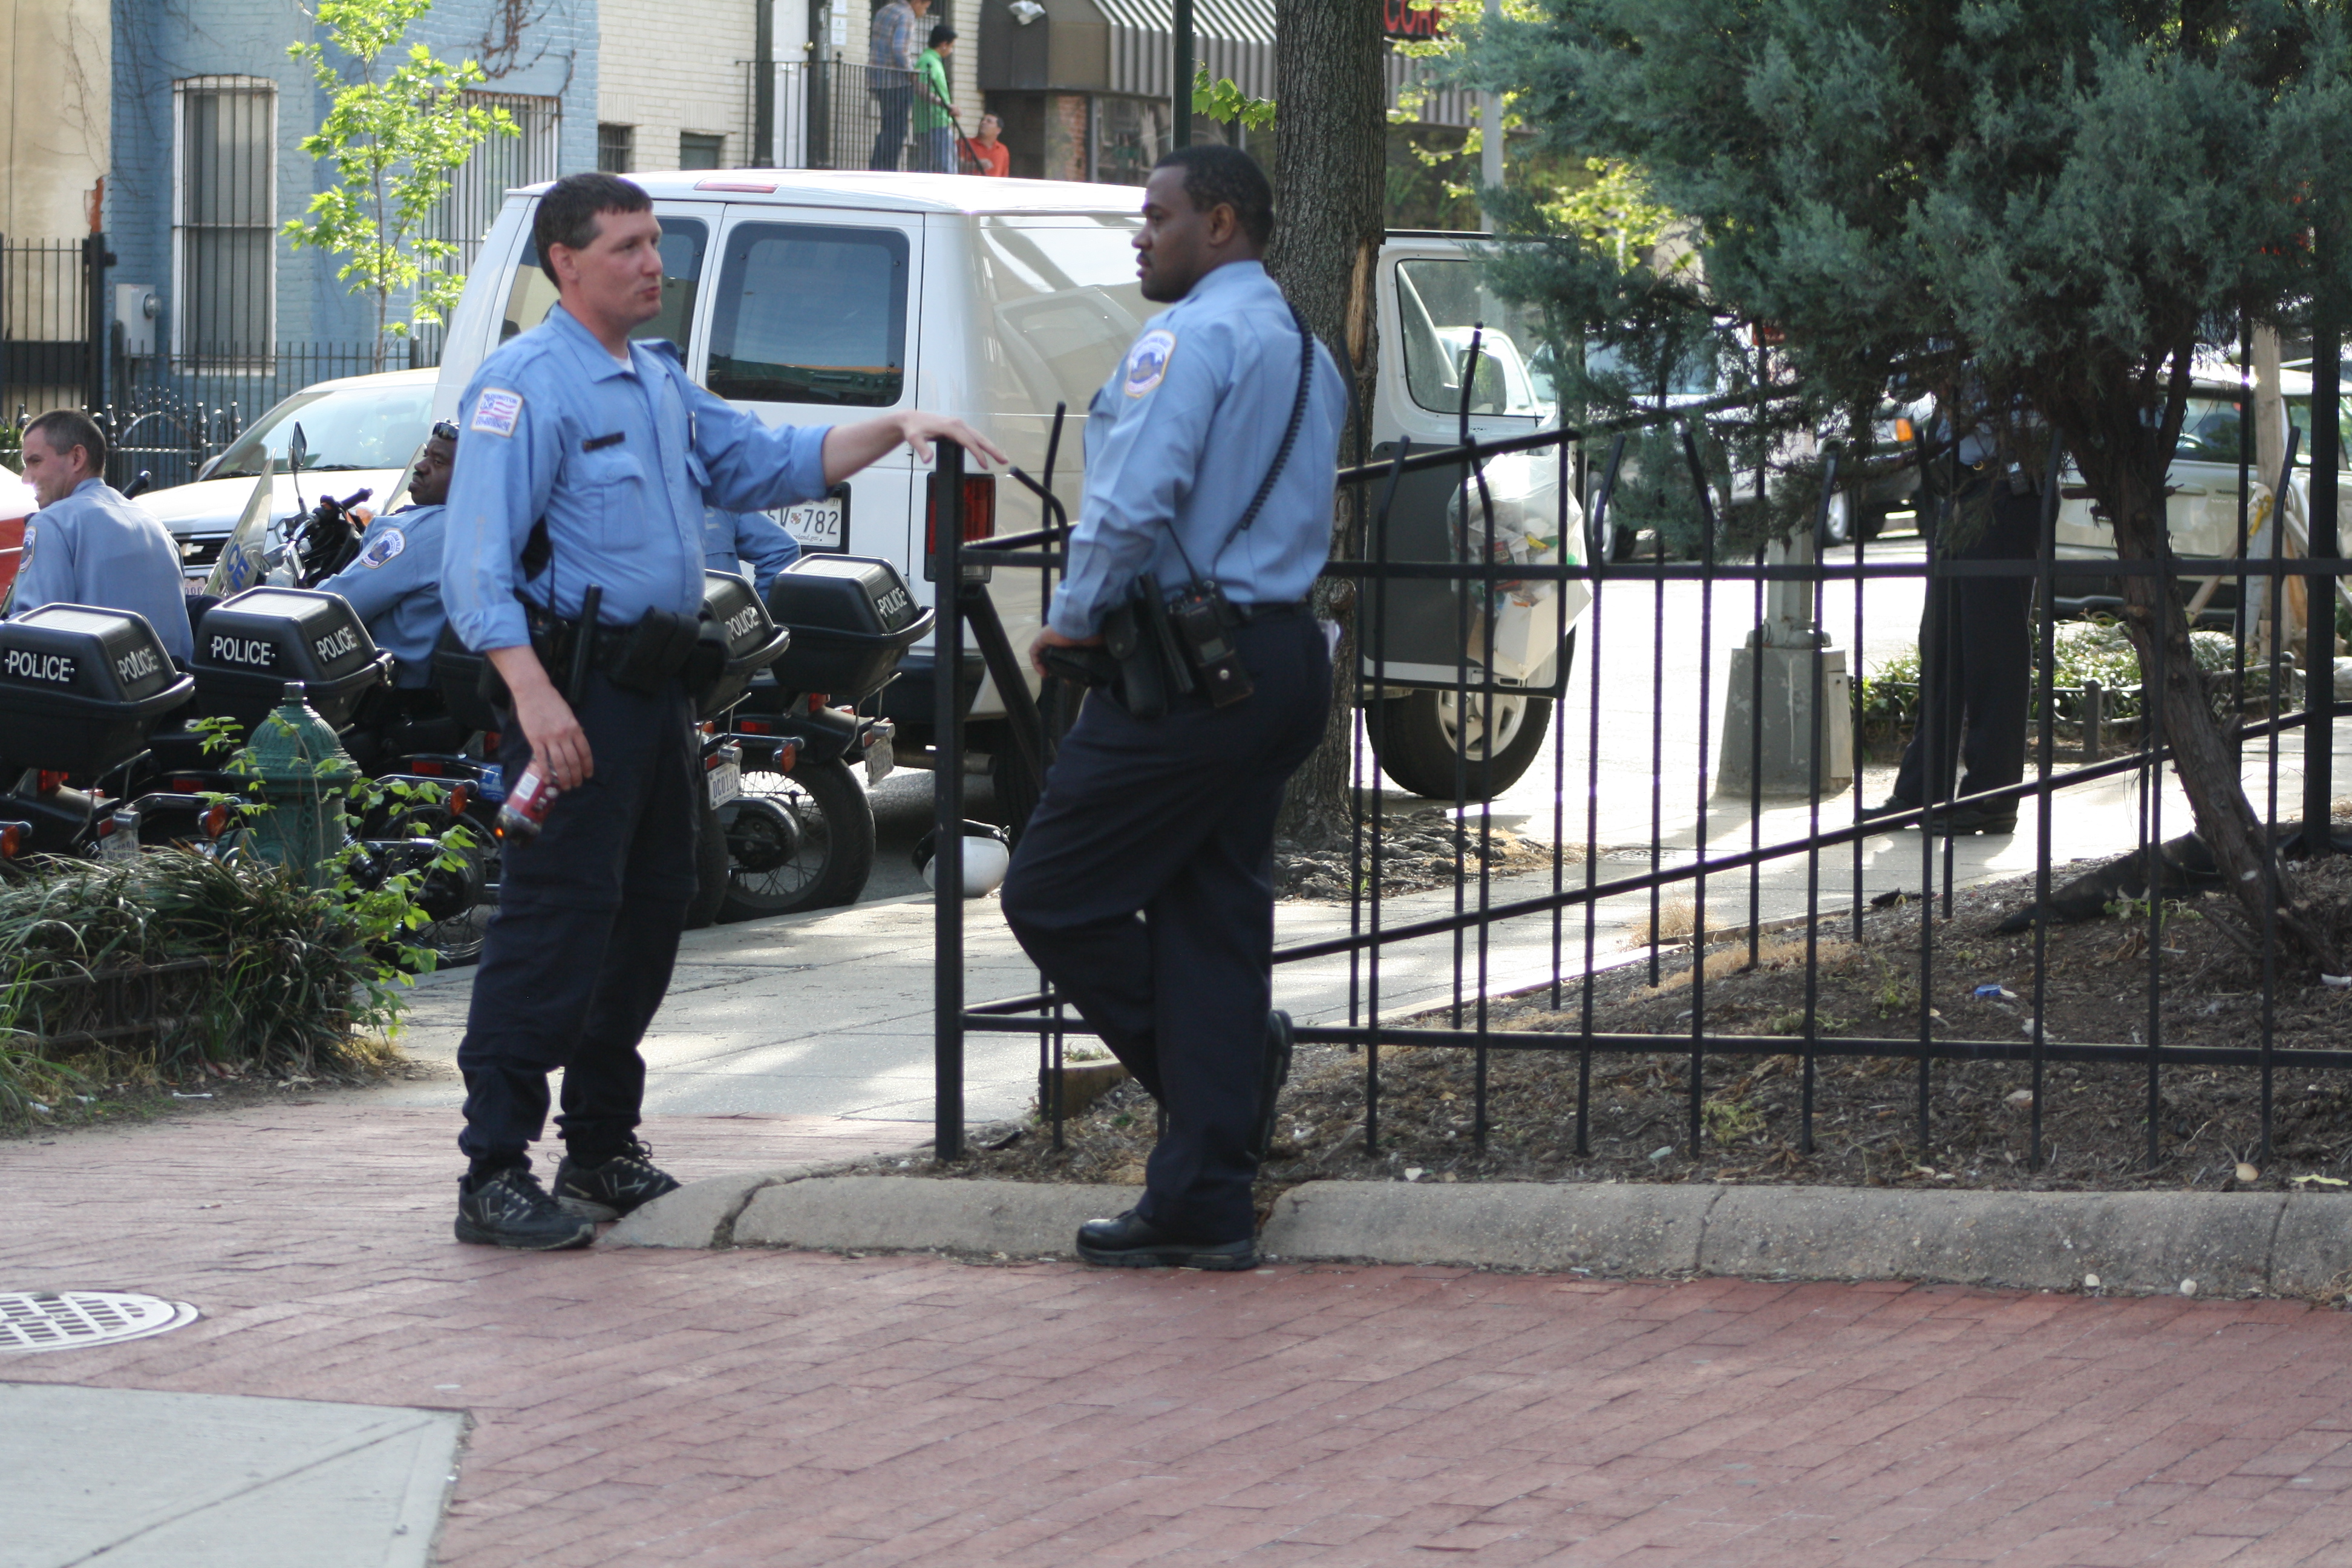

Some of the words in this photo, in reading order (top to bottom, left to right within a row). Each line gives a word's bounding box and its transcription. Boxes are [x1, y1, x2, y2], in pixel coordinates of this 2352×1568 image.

[803, 509, 838, 535] 782
[878, 587, 907, 618] POLICE
[725, 606, 759, 641] POLICE
[213, 636, 271, 665] POLICE
[316, 626, 358, 662] POLICE
[8, 650, 71, 682] POLICE
[117, 647, 158, 682] POLICE
